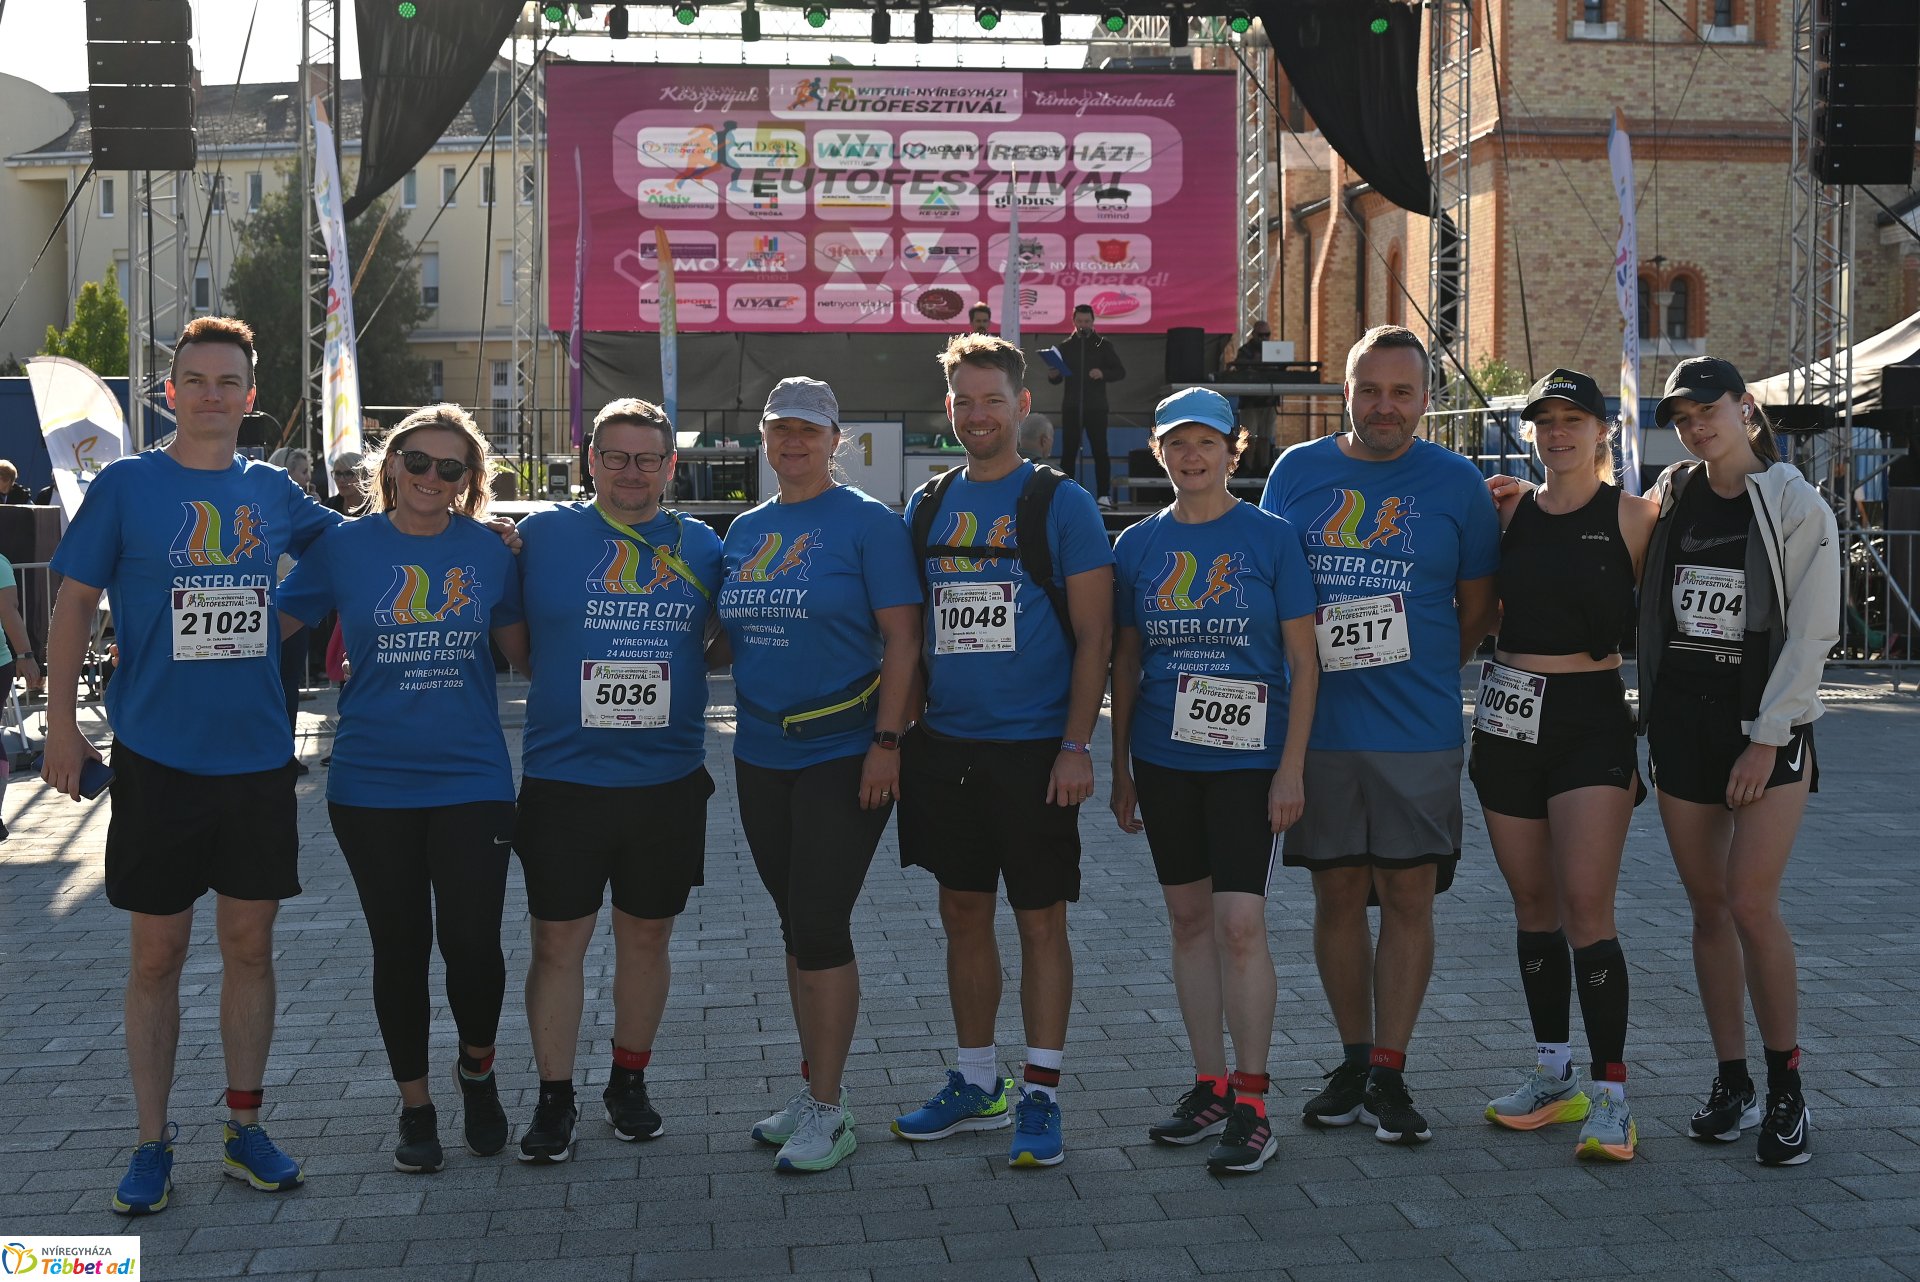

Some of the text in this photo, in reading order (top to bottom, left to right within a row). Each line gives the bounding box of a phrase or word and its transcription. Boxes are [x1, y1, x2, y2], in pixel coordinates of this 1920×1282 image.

[660, 84, 759, 112] Köszönjük
[858, 85, 1007, 98] WITTUR-NYÍREGYHÁZI
[827, 97, 1007, 113] FUTÓFESZTIVÁL
[859, 432, 872, 466] 1
[1307, 554, 1414, 577] SISTER CITY
[173, 574, 271, 591] SISTER CITY
[1313, 573, 1412, 592] UNNING FESTIVAL
[720, 588, 808, 606] SISTER CITY
[1680, 589, 1743, 616] 5104
[586, 600, 695, 619] SISTER CITY
[720, 607, 809, 619] RUNNING FESTIVAL
[941, 606, 1007, 630] 10048
[181, 610, 262, 635] 21023
[583, 617, 692, 632] RUNNING FESTIVAL
[1146, 617, 1249, 635] SISTER CITY
[377, 630, 481, 649] SISTER CITY
[612, 636, 669, 647] NYÍREGYHÁZA
[750, 636, 771, 646] AUGUST
[772, 639, 790, 647] 2025
[1150, 635, 1250, 647] RUNNING FESTIVAL
[1331, 618, 1393, 647] 2517
[377, 650, 431, 663] RUNNING
[607, 650, 673, 659] 24 AUGUST 2025
[1173, 648, 1225, 659] NYÍREGYHÁZA
[405, 667, 459, 678] NYÍREGYHÁZA
[1167, 662, 1230, 671] 24 AUGUST 2025
[400, 680, 464, 690] 24 AUGUST 2025
[595, 683, 657, 705] 5036
[1480, 685, 1535, 718] 10066
[1189, 698, 1252, 726] 5086
